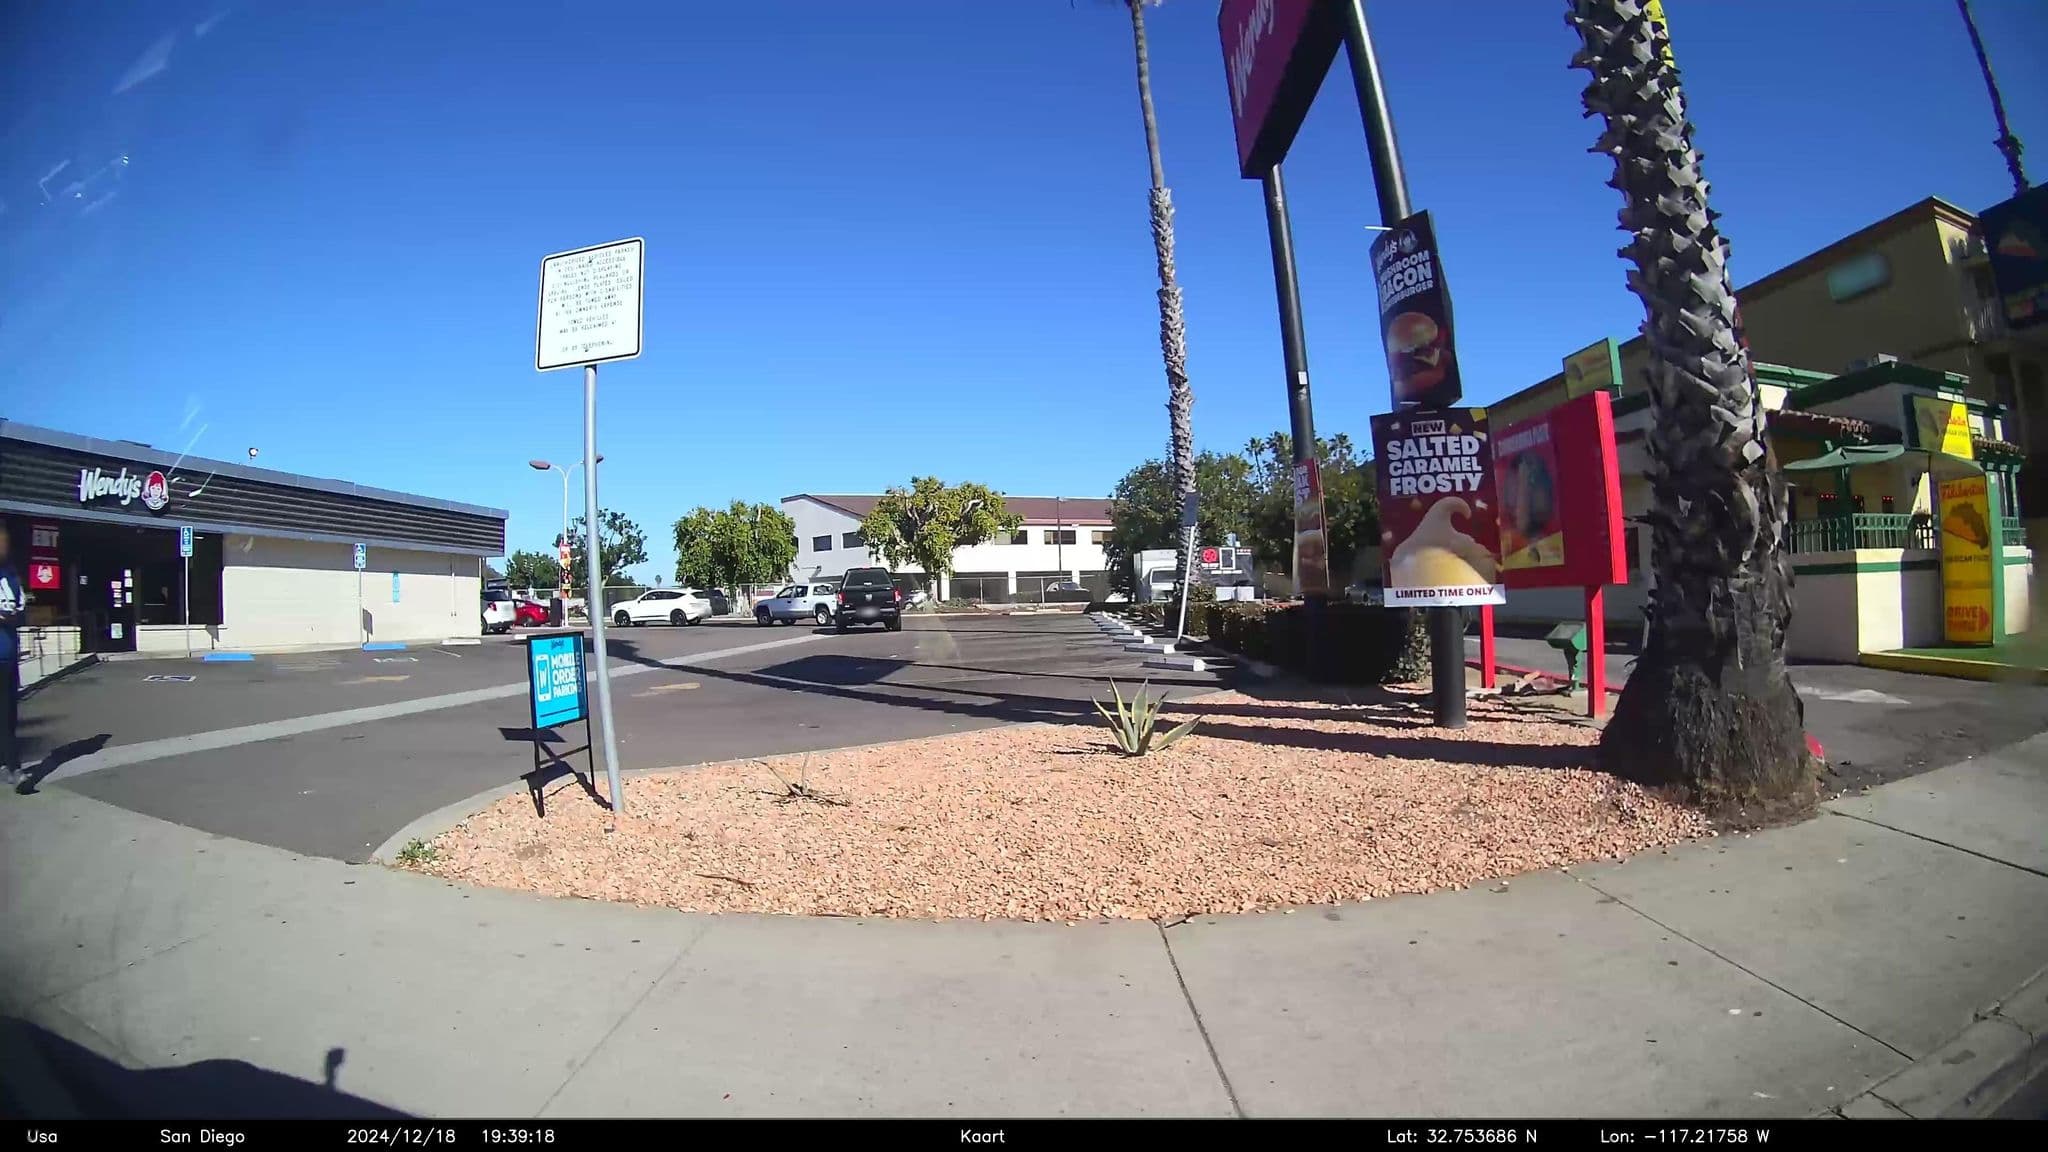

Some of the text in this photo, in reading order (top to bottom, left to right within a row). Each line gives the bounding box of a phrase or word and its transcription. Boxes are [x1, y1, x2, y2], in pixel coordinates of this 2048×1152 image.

[1413, 420, 1444, 434] NEW
[1387, 435, 1480, 460] SALTED
[1389, 456, 1482, 476] CARAMEL
[79, 467, 142, 506] Wendy's
[1390, 473, 1484, 496] FROSTY
[1395, 586, 1494, 599] LIMITED TIME ONLY
[550, 652, 580, 669] MOBILE
[552, 666, 581, 685] ORDER
